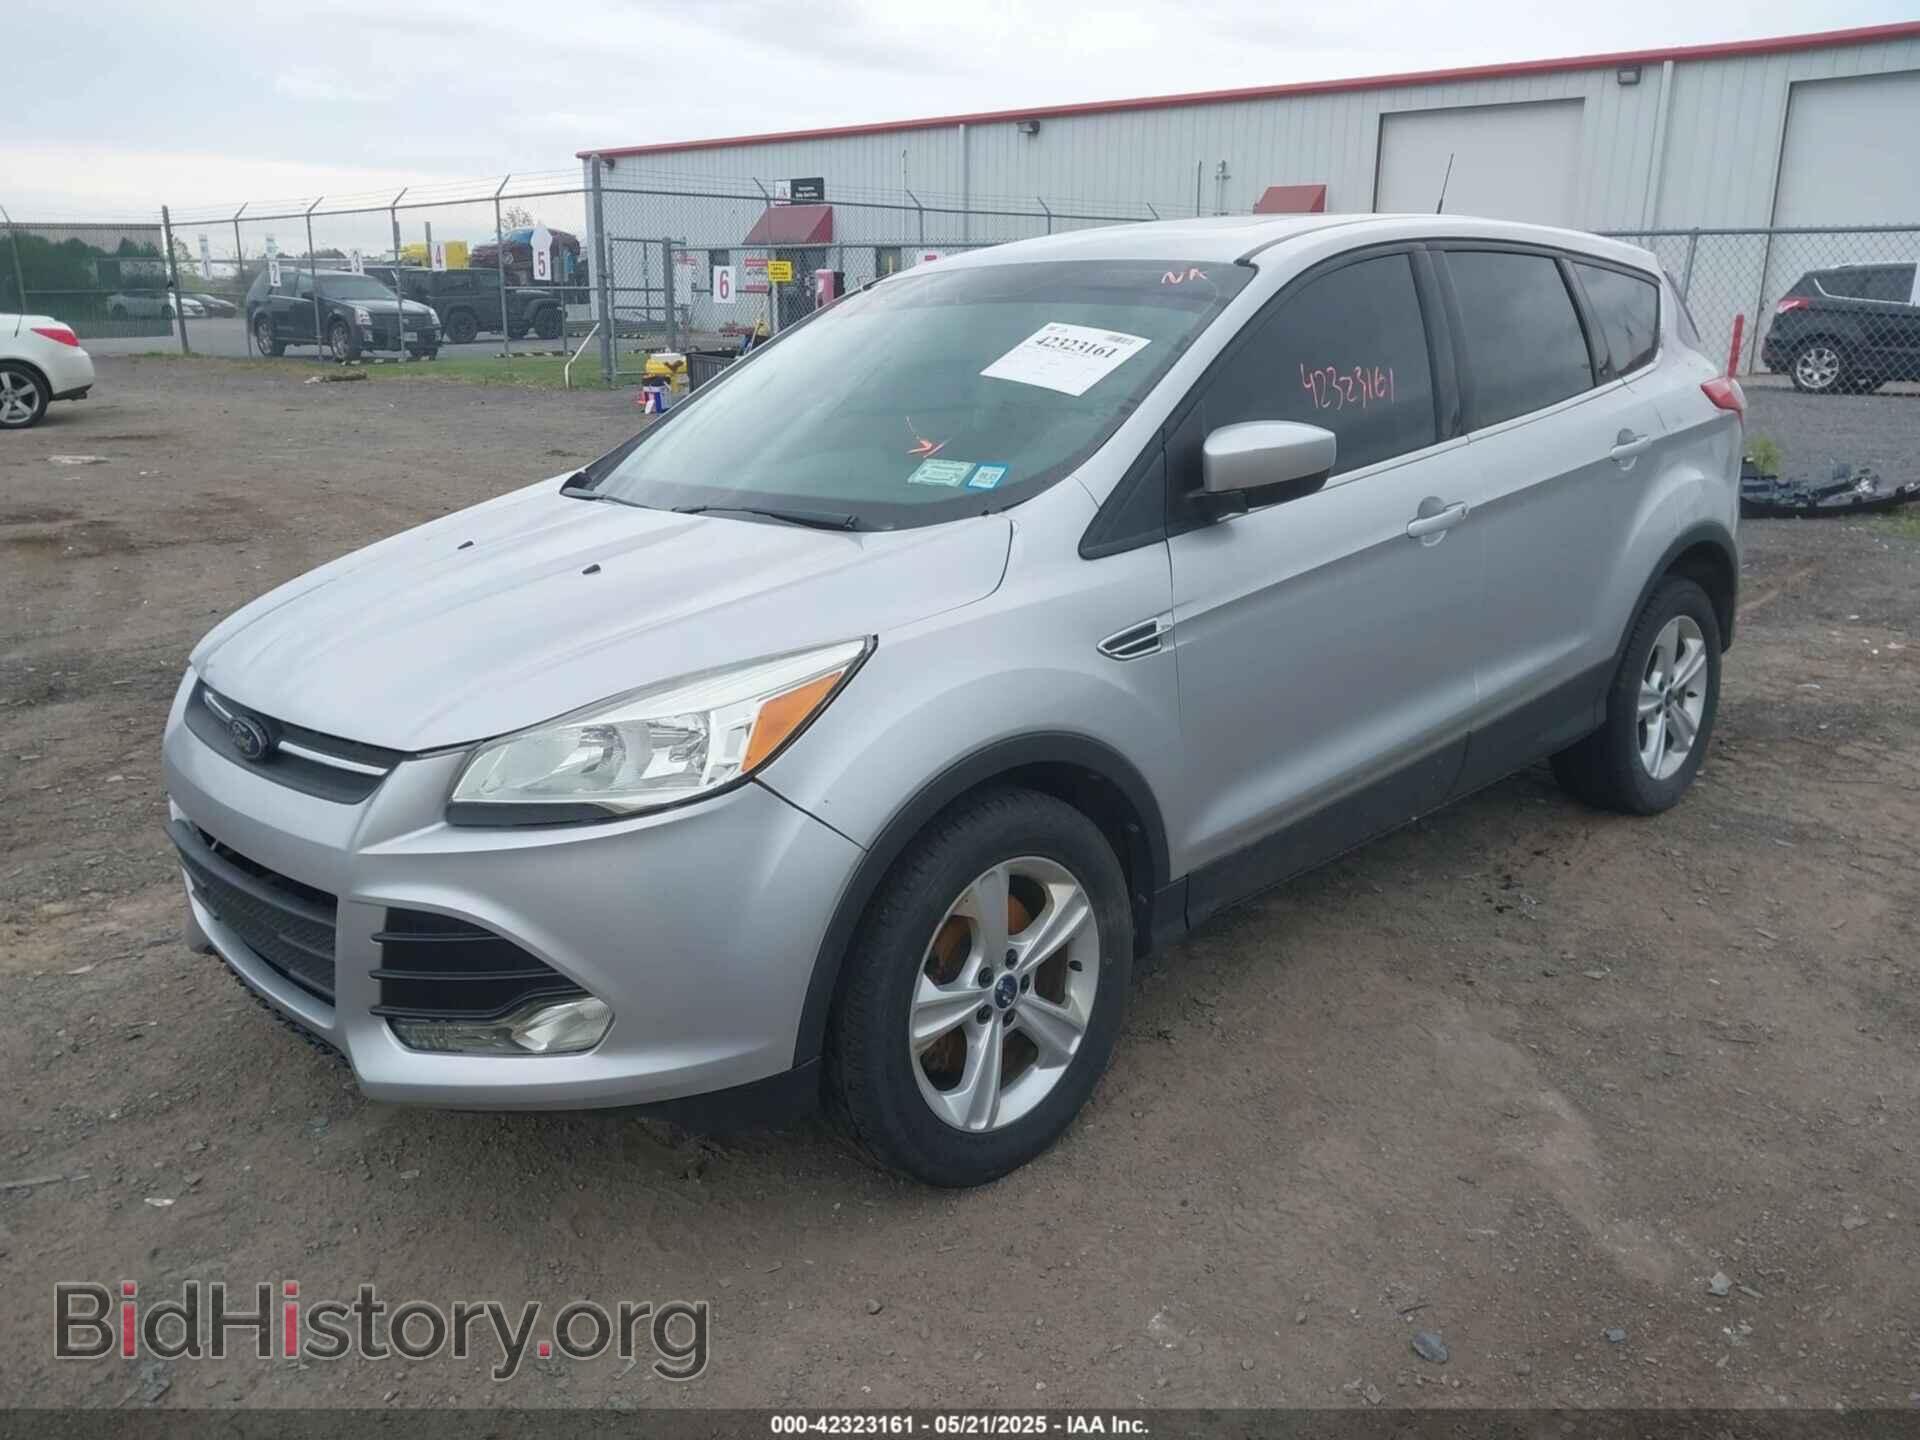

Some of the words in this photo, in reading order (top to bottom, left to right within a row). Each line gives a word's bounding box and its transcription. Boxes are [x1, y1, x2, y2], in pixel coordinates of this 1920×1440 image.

[435, 245, 442, 268] 4
[538, 251, 546, 277] 5
[719, 270, 730, 300] 6
[1036, 335, 1119, 359] 42323161
[1300, 362, 1395, 411] 42323161
